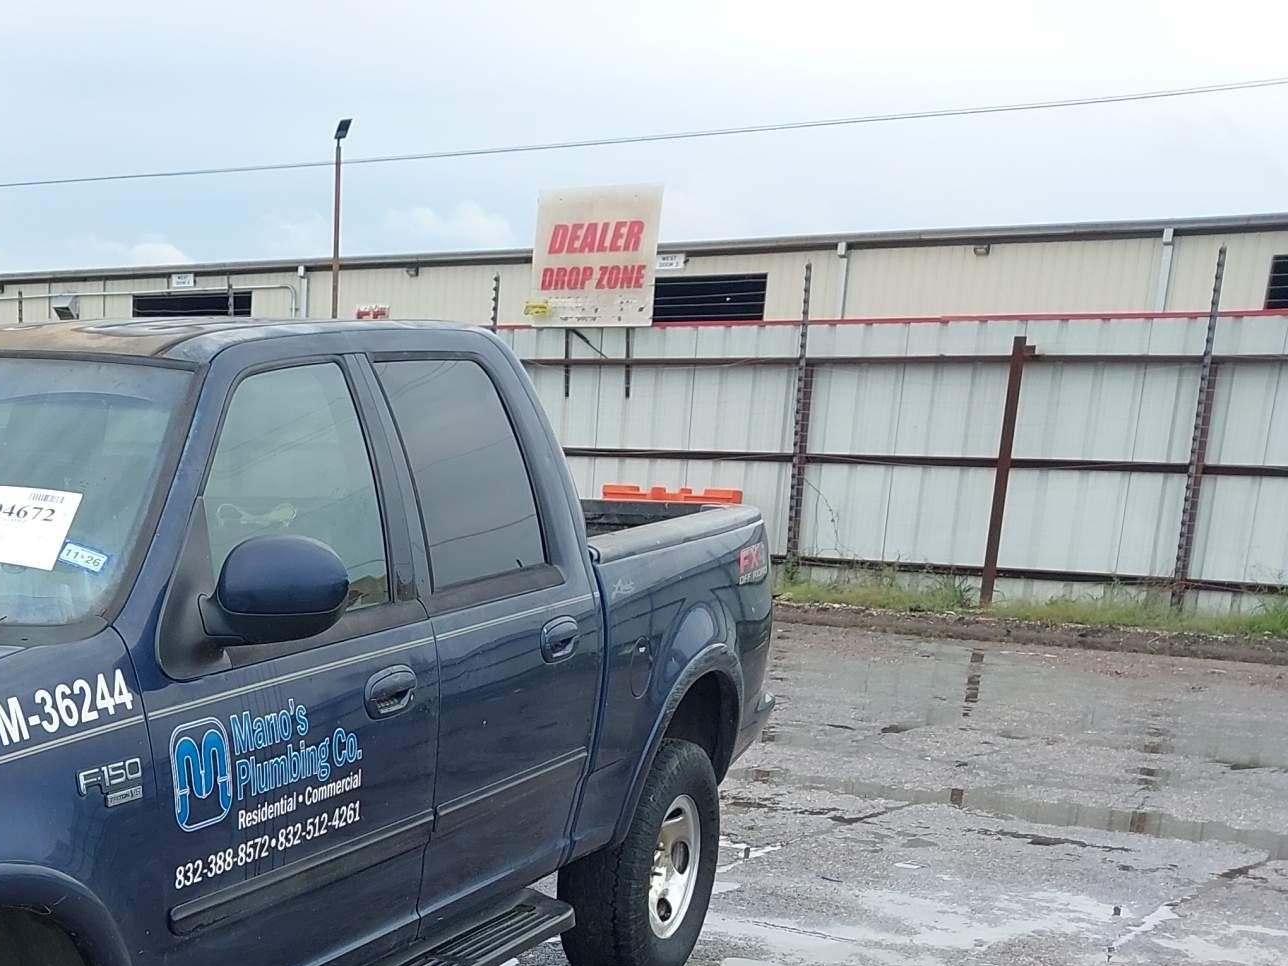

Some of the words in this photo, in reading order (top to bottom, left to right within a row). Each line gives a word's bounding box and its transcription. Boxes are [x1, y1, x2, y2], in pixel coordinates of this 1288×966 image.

[548, 220, 646, 255] DEALER
[541, 266, 594, 291] DROP
[595, 264, 647, 290] ZONE
[236, 737, 331, 801] Plumbing
[332, 727, 363, 767] Co.
[238, 794, 298, 831] Residential
[305, 768, 363, 806] Commercial
[174, 835, 270, 891] 832-388-8572
[277, 800, 362, 852] 832-512-4261
